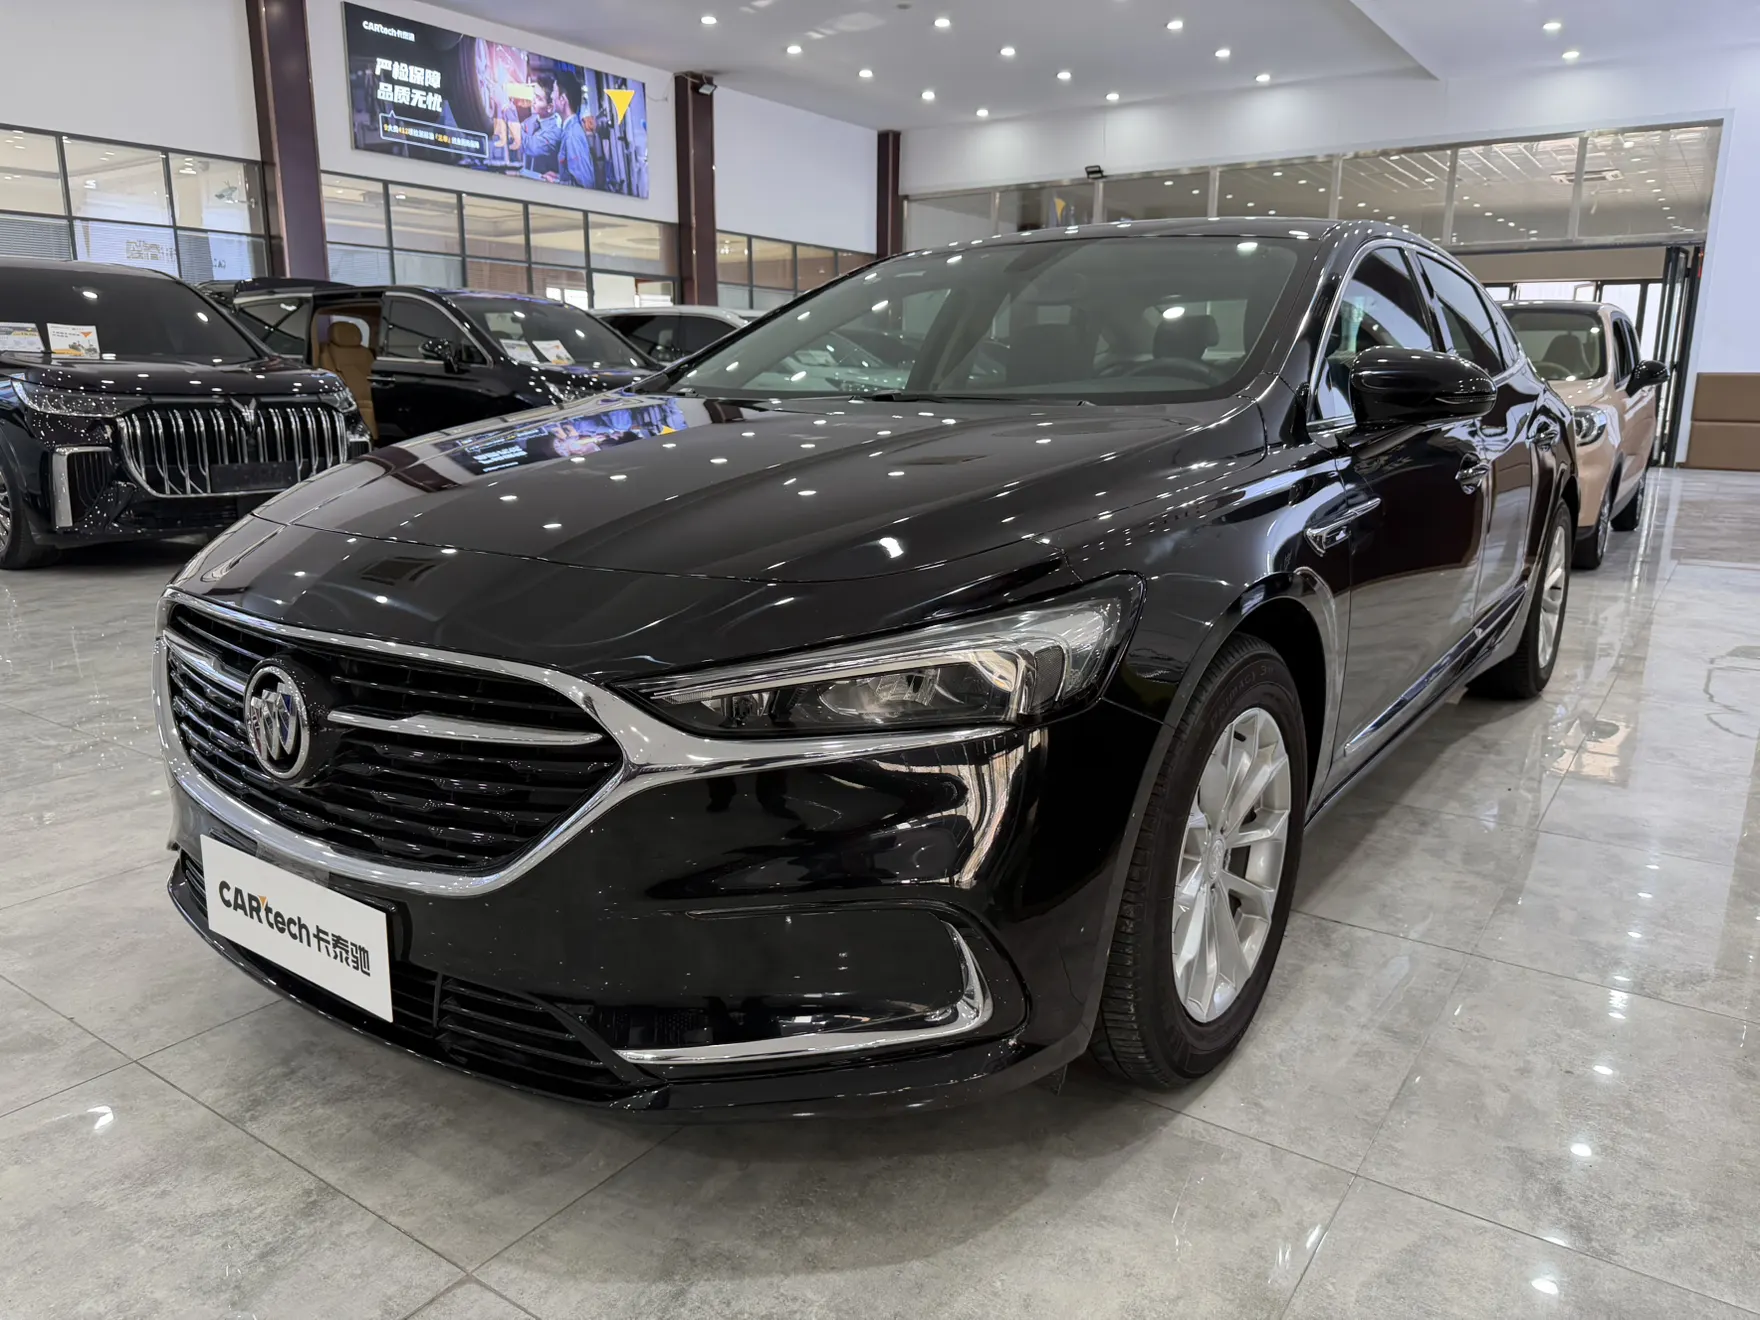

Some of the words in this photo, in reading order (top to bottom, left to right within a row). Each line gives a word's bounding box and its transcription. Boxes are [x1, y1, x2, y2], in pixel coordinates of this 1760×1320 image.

[375, 58, 441, 88] 严检保障
[377, 81, 442, 112] 品质无忧
[219, 880, 311, 947] CARtech
[313, 925, 371, 977] 卡泰驰
